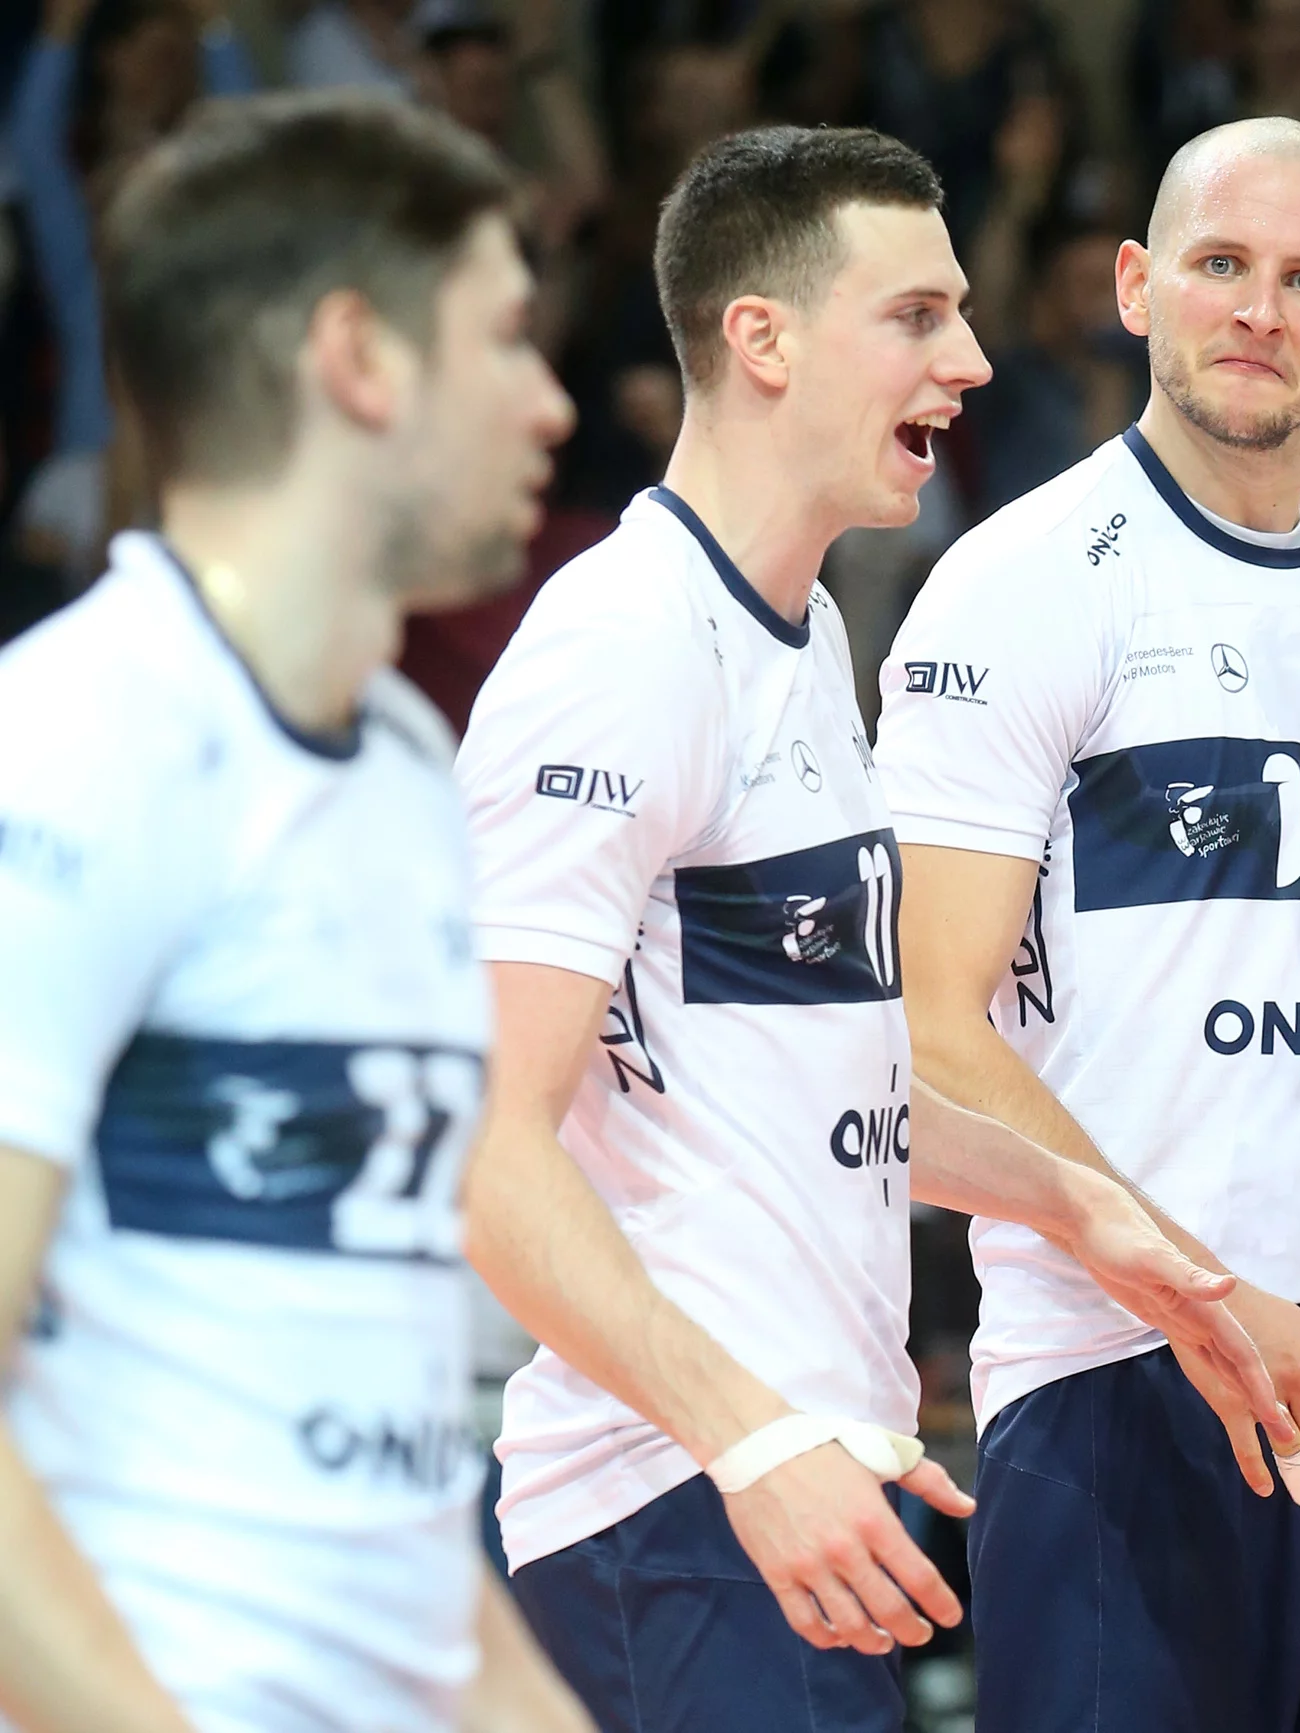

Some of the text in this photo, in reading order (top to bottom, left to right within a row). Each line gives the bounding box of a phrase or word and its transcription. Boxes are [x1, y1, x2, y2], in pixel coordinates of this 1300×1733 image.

[1125, 646, 1194, 664] ercedes-Benz
[933, 662, 990, 699] JW
[578, 768, 645, 806] JW
